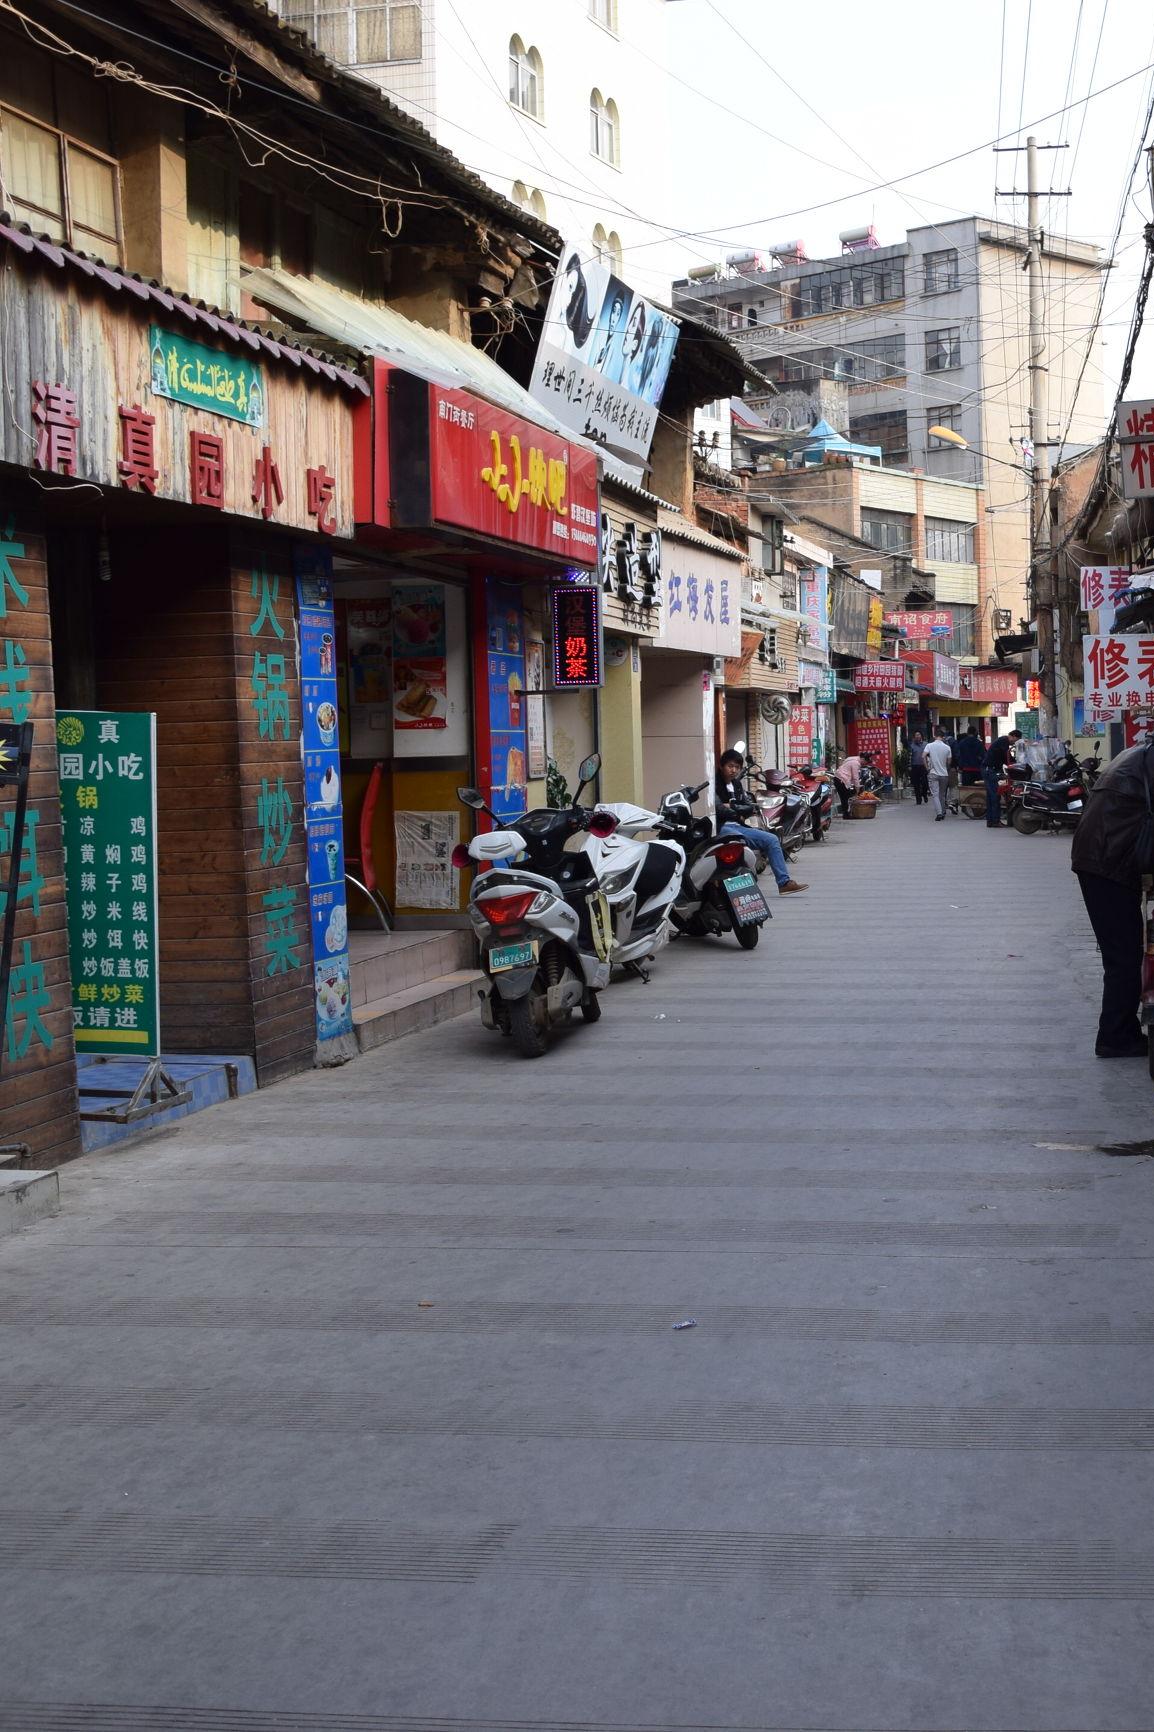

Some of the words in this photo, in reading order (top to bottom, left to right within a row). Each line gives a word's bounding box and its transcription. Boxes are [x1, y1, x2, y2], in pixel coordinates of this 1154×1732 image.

[32, 379, 337, 535] 清真园小吃
[888, 612, 948, 626] 南诏食府
[98, 720, 120, 744] 真
[60, 753, 144, 781] 园小吃
[82, 957, 150, 979] 炒饭盖饭
[493, 951, 530, 967] 0987697
[74, 983, 145, 1004] 鲜炒菜
